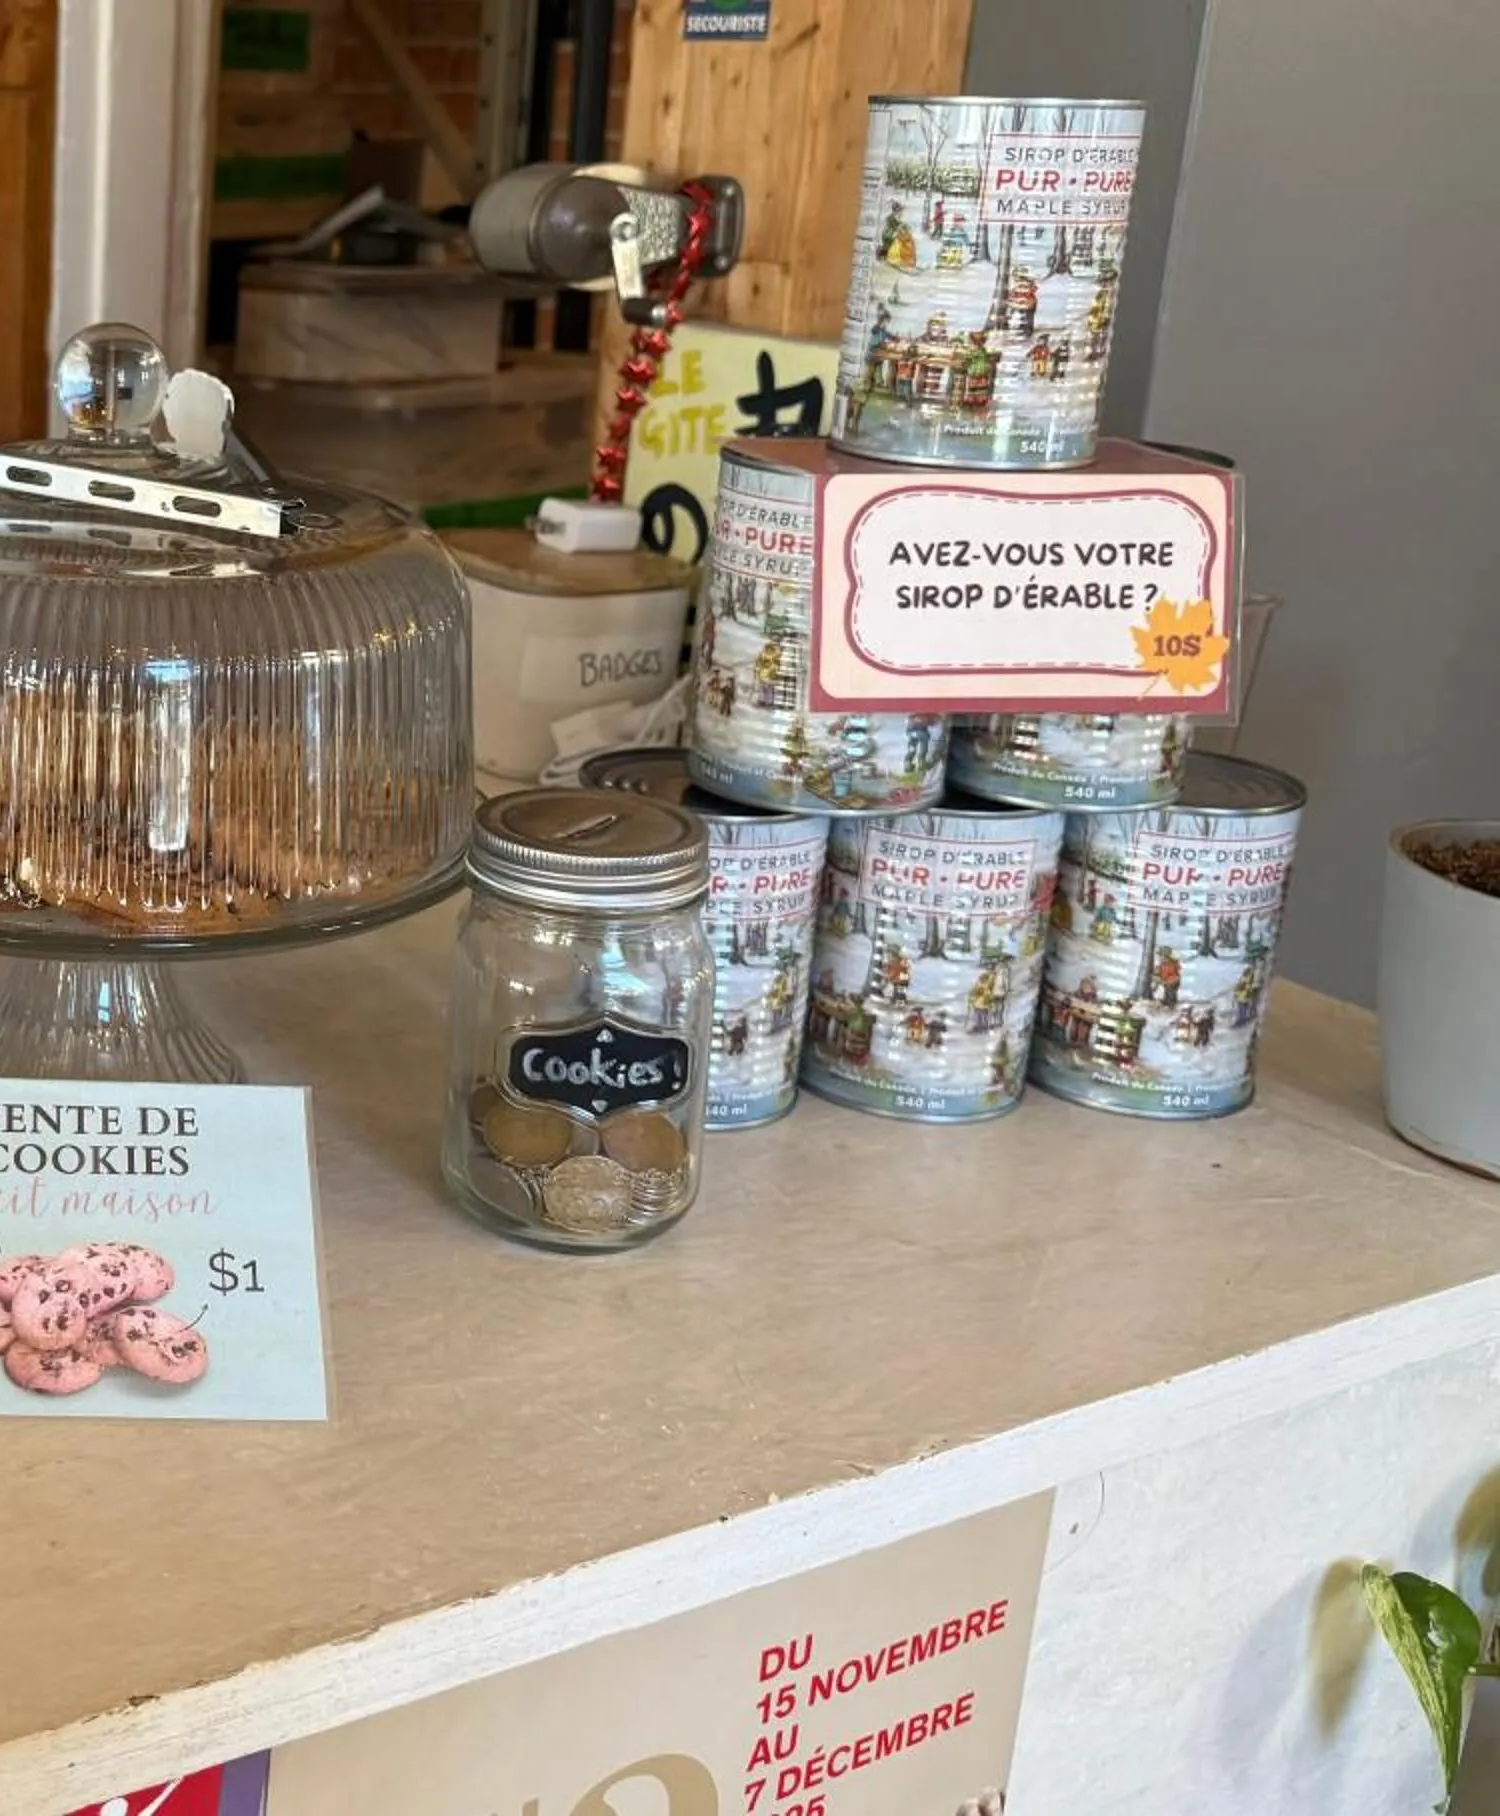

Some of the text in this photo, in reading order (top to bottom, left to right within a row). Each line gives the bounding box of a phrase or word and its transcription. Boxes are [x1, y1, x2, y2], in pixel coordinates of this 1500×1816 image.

[686, 15, 767, 33] SECOURISTE
[1004, 146, 1065, 163] SIROP
[996, 168, 1132, 193] PUR PURE
[997, 199, 1072, 215] MAPLE
[745, 526, 812, 555] PURE
[890, 541, 1174, 567] AVEZ-VOUS VOTRE
[896, 583, 983, 609] SIROP
[993, 574, 1134, 609] D'ÉRABLE
[1153, 634, 1202, 658] 10$
[578, 649, 662, 688] BADGES
[1063, 786, 1116, 799] 540 ml
[880, 839, 936, 861] SIROP
[871, 857, 1027, 892] PUR PURE
[1228, 862, 1285, 887] PURE
[871, 883, 1019, 910] MAPLE SYRUP
[1227, 886, 1277, 907] SYRUP
[730, 1103, 748, 1116] ml
[896, 1095, 925, 1109] 540
[1162, 1094, 1209, 1107] 540 ml
[137, 1106, 200, 1138] DE
[58, 1185, 219, 1225] maison
[208, 1247, 266, 1297] $1
[756, 1599, 1009, 1725] 15 NOVEMBRE
[758, 1632, 814, 1683] DU
[744, 1777, 767, 1813] 7
[775, 1691, 975, 1801] DÉCEMBRE
[746, 1723, 800, 1773] AU
